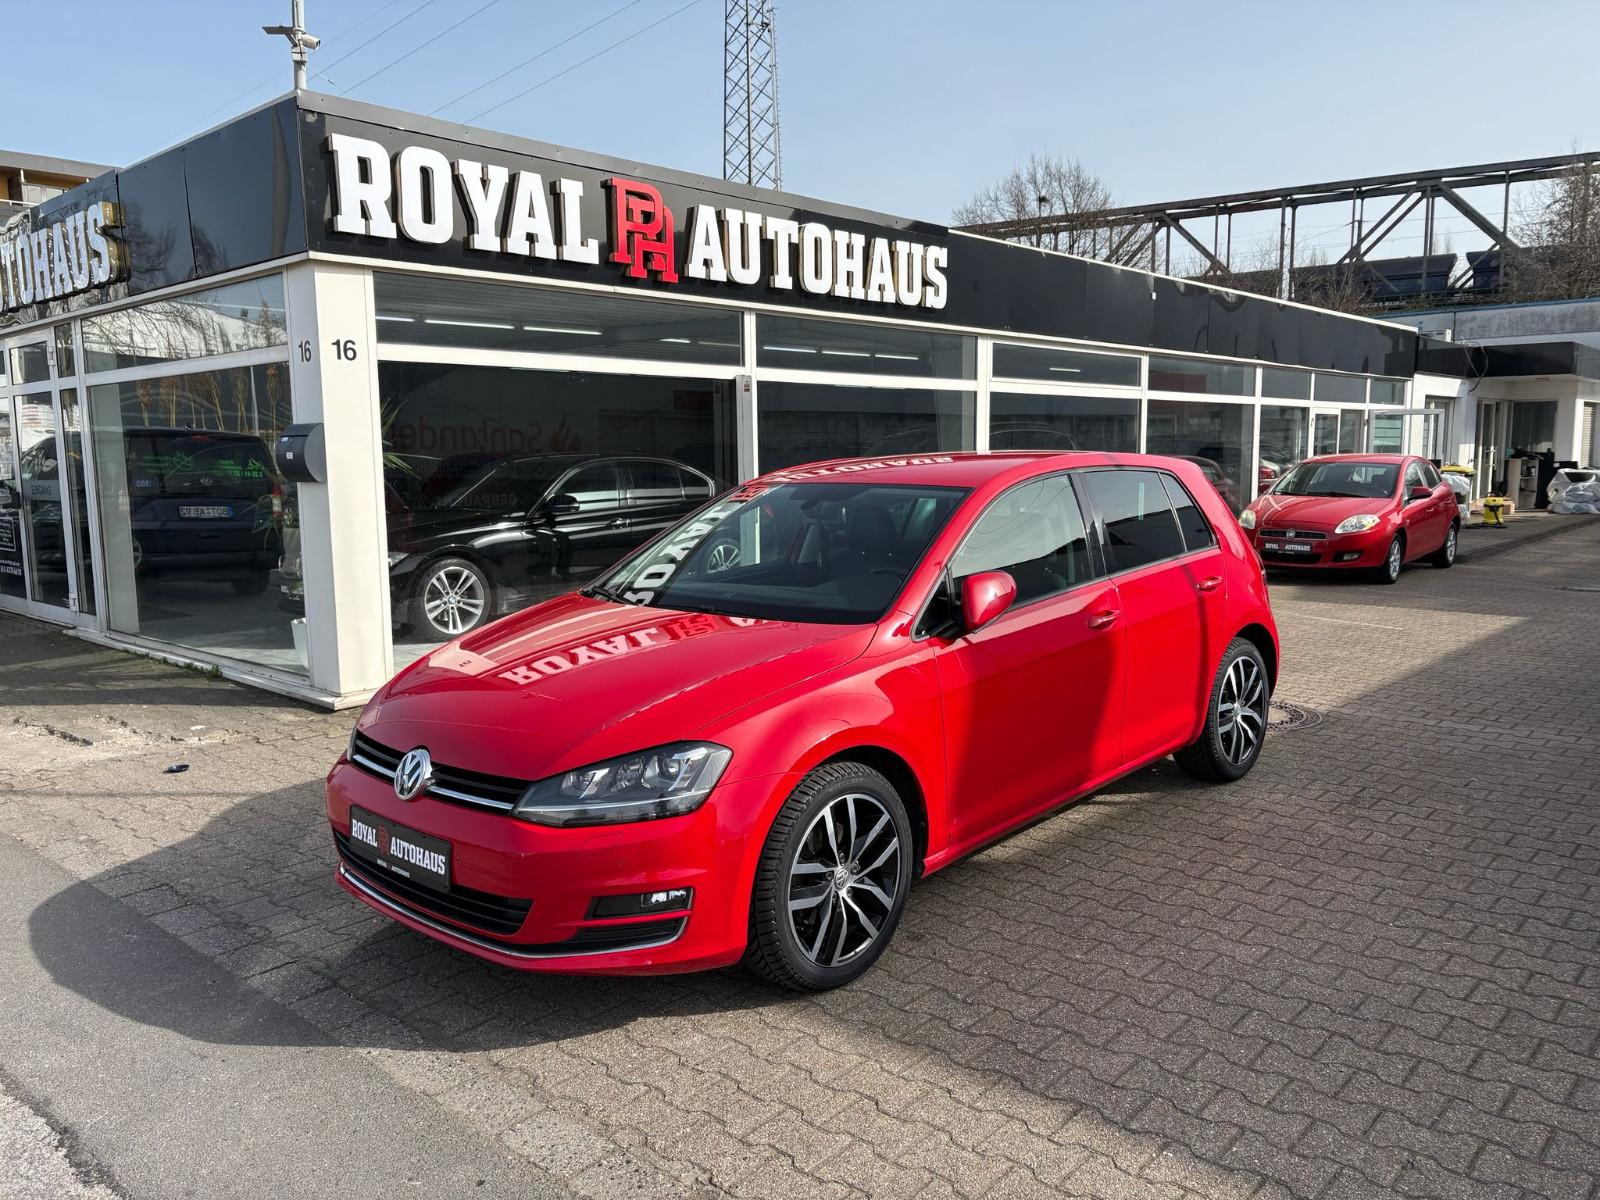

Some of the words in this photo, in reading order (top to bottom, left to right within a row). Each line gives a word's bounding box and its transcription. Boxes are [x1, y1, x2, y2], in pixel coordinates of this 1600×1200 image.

[328, 133, 600, 265] ROYAL
[685, 203, 949, 310] AUTOHAUS
[0, 201, 113, 313] TOHAUS
[298, 340, 312, 362] 16
[331, 339, 357, 361] 16
[352, 818, 378, 848] ROYAL
[390, 836, 446, 876] AUTOHAUS
